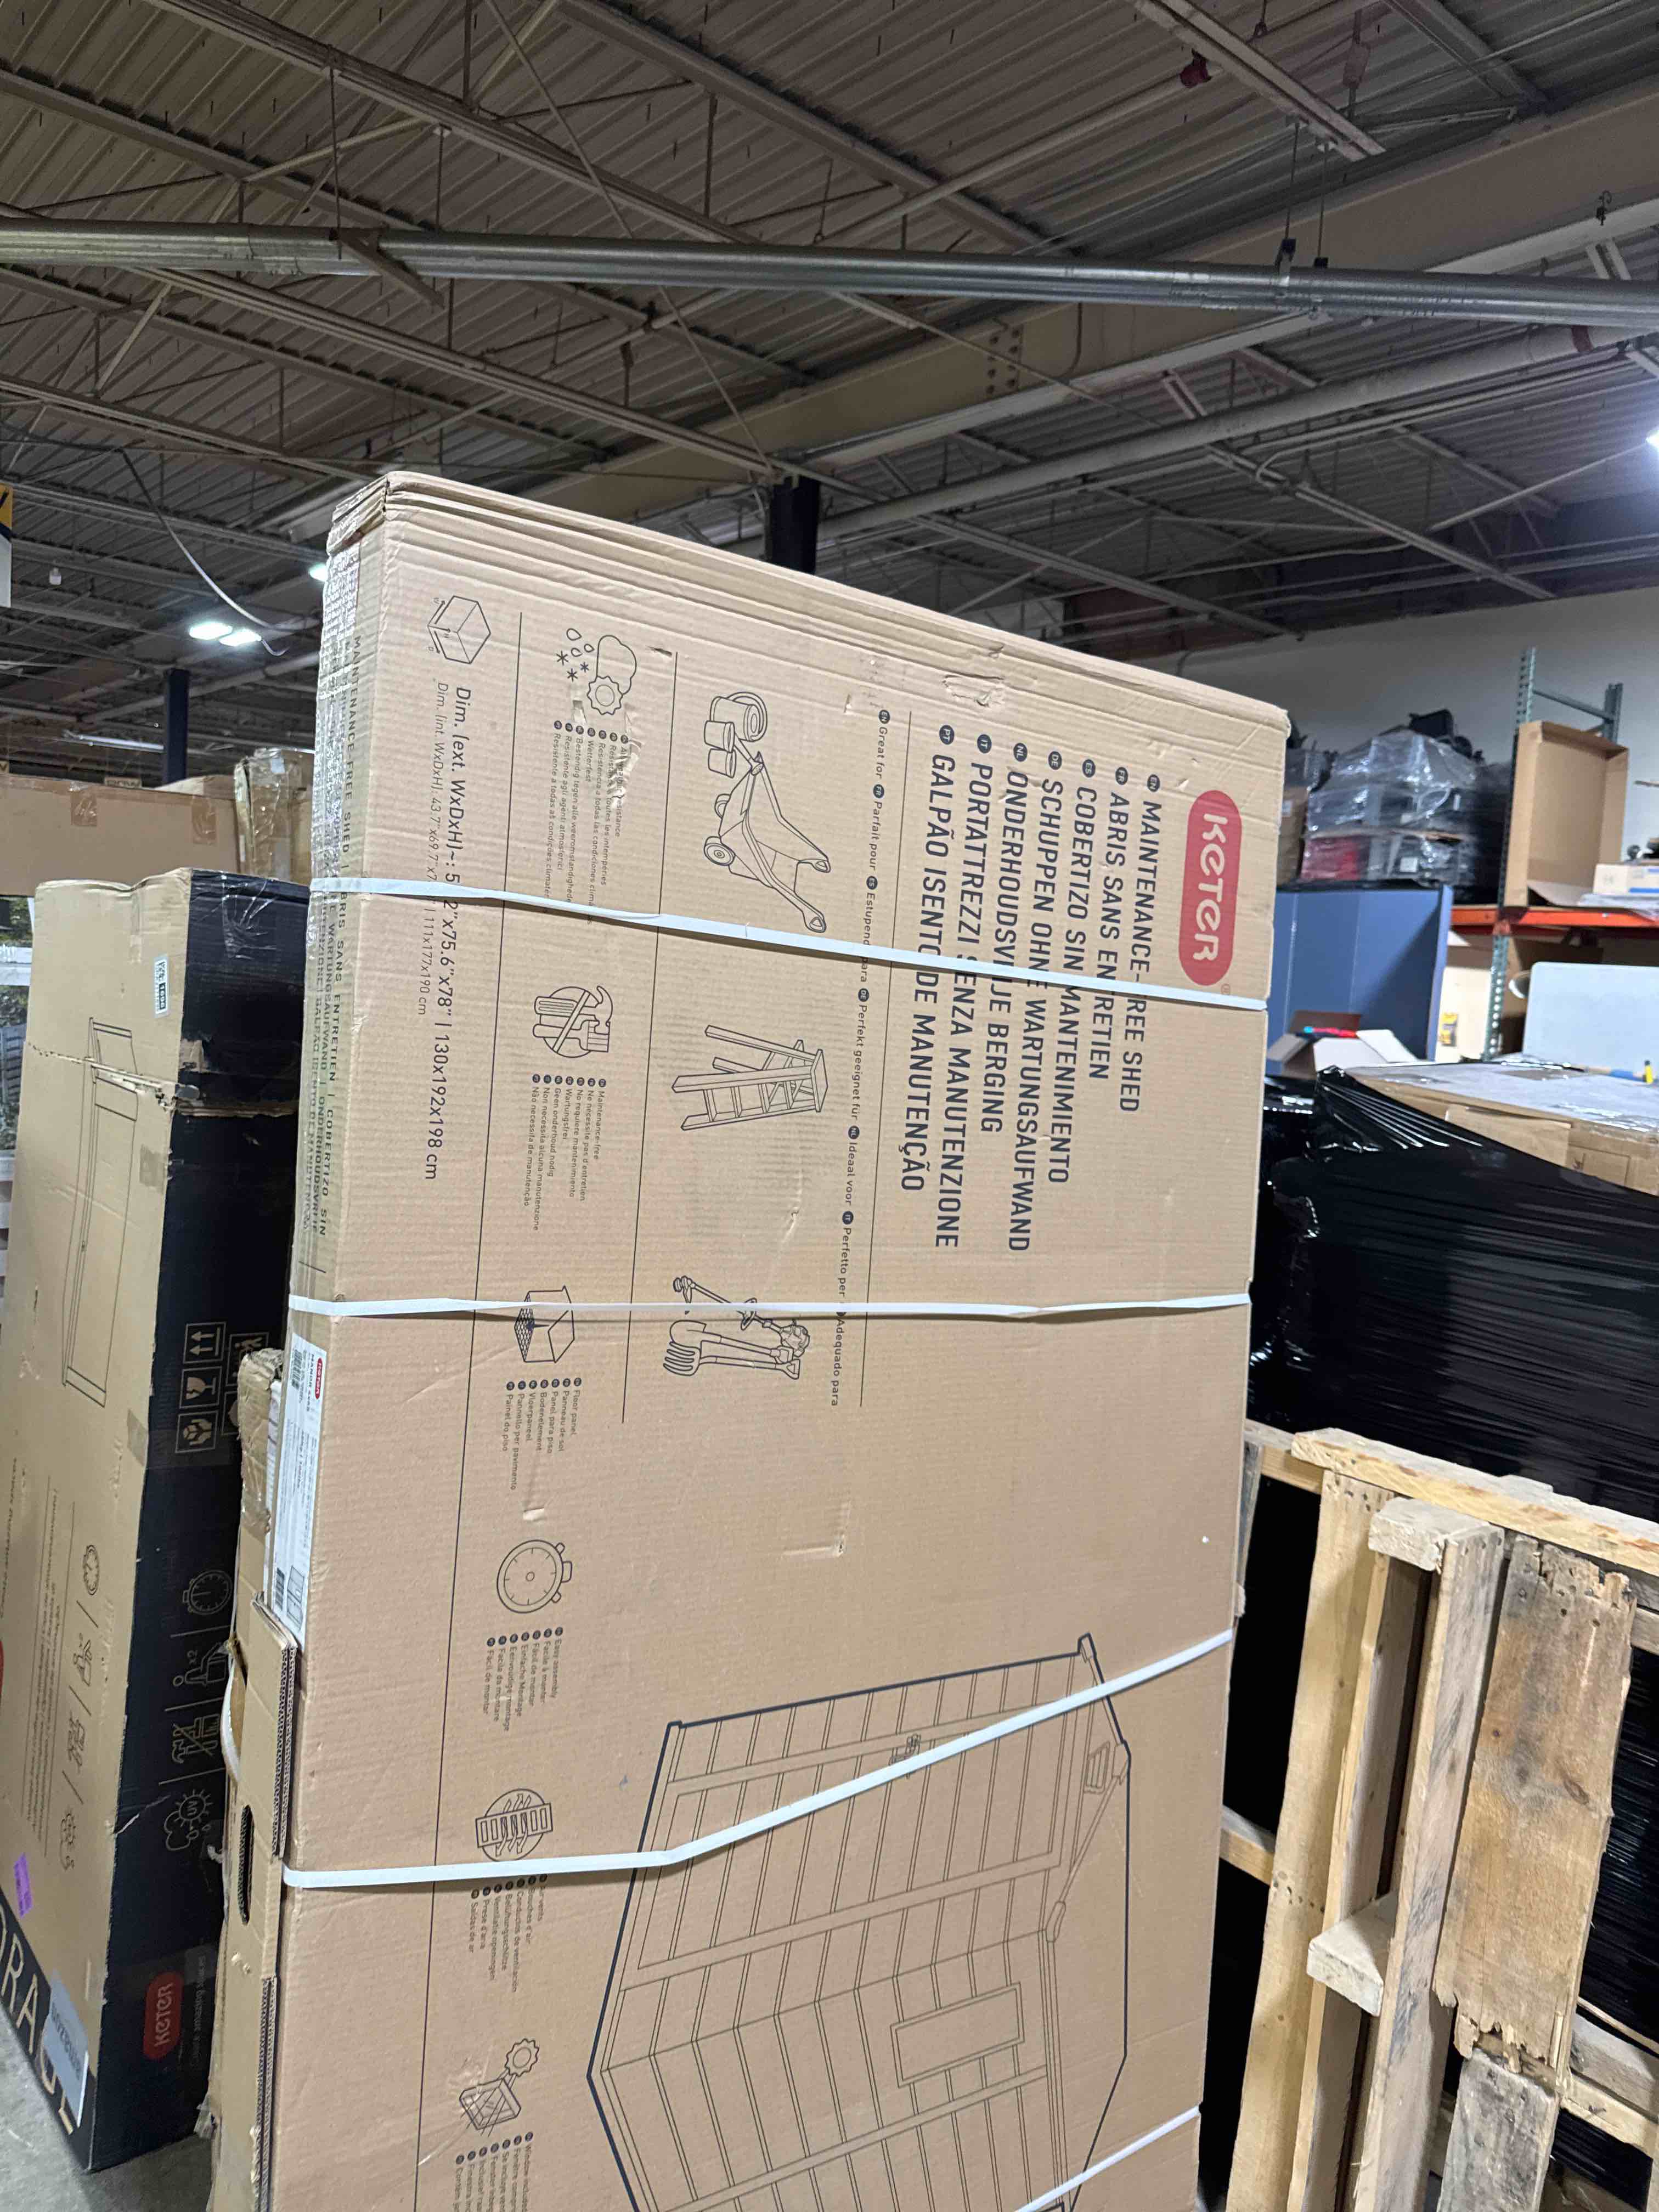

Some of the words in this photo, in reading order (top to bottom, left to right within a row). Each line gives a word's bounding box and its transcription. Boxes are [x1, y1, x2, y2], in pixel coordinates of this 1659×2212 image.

[436, 682, 449, 711] Dim.
[454, 686, 471, 728] Dim.
[449, 733, 470, 772] (ext.
[876, 726, 888, 759] Great
[875, 761, 885, 780] for
[871, 800, 883, 840] Parfait
[924, 754, 956, 858] GALPÃO
[1104, 791, 1130, 867] ABRIS
[341, 810, 352, 854] SHED
[866, 842, 877, 871] pour
[957, 761, 994, 944] PORTATTREZZI
[1032, 778, 1064, 912] SCHUPPEN
[1066, 786, 1098, 920] COBERTIZO
[861, 891, 876, 945] Estupend
[1099, 875, 1124, 940] SANS
[1124, 800, 1162, 1042] MAINTENANCE-REE
[334, 939, 345, 982] SANS
[419, 916, 435, 994] 111x177x190
[1026, 921, 1053, 990] OHNE
[1062, 928, 1087, 971] SIN
[417, 996, 427, 1015] cm
[913, 970, 939, 1004] DE
[328, 992, 341, 1081] ENTRETIEN
[855, 1004, 867, 1047] Perfekt
[1088, 949, 1119, 1079] ENRETIEN
[427, 1034, 450, 1149] 130x192x198
[849, 1049, 864, 1101] geeignet
[980, 1023, 1010, 1133] BERGING
[1047, 984, 1082, 1183] MANTENIMIENTO
[1119, 1050, 1143, 1112] SHED
[850, 1103, 861, 1121] für
[898, 1014, 936, 1192] MANUTENÇÃO
[1007, 997, 1047, 1252] WARTUNGSAUFWAND
[320, 1108, 334, 1197] COBERTIZO
[425, 1153, 438, 1180] cm
[846, 1141, 857, 1177] Ideaal
[934, 1047, 972, 1249] MANUTENZIONE
[844, 1180, 853, 1206] voor
[319, 1206, 328, 1236] SIN
[839, 1227, 852, 1274] Perfetto
[836, 1277, 847, 1297] per
[831, 1317, 845, 1377] Adequado
[829, 1379, 839, 1407] para
[187, 1801, 198, 1816] UV
